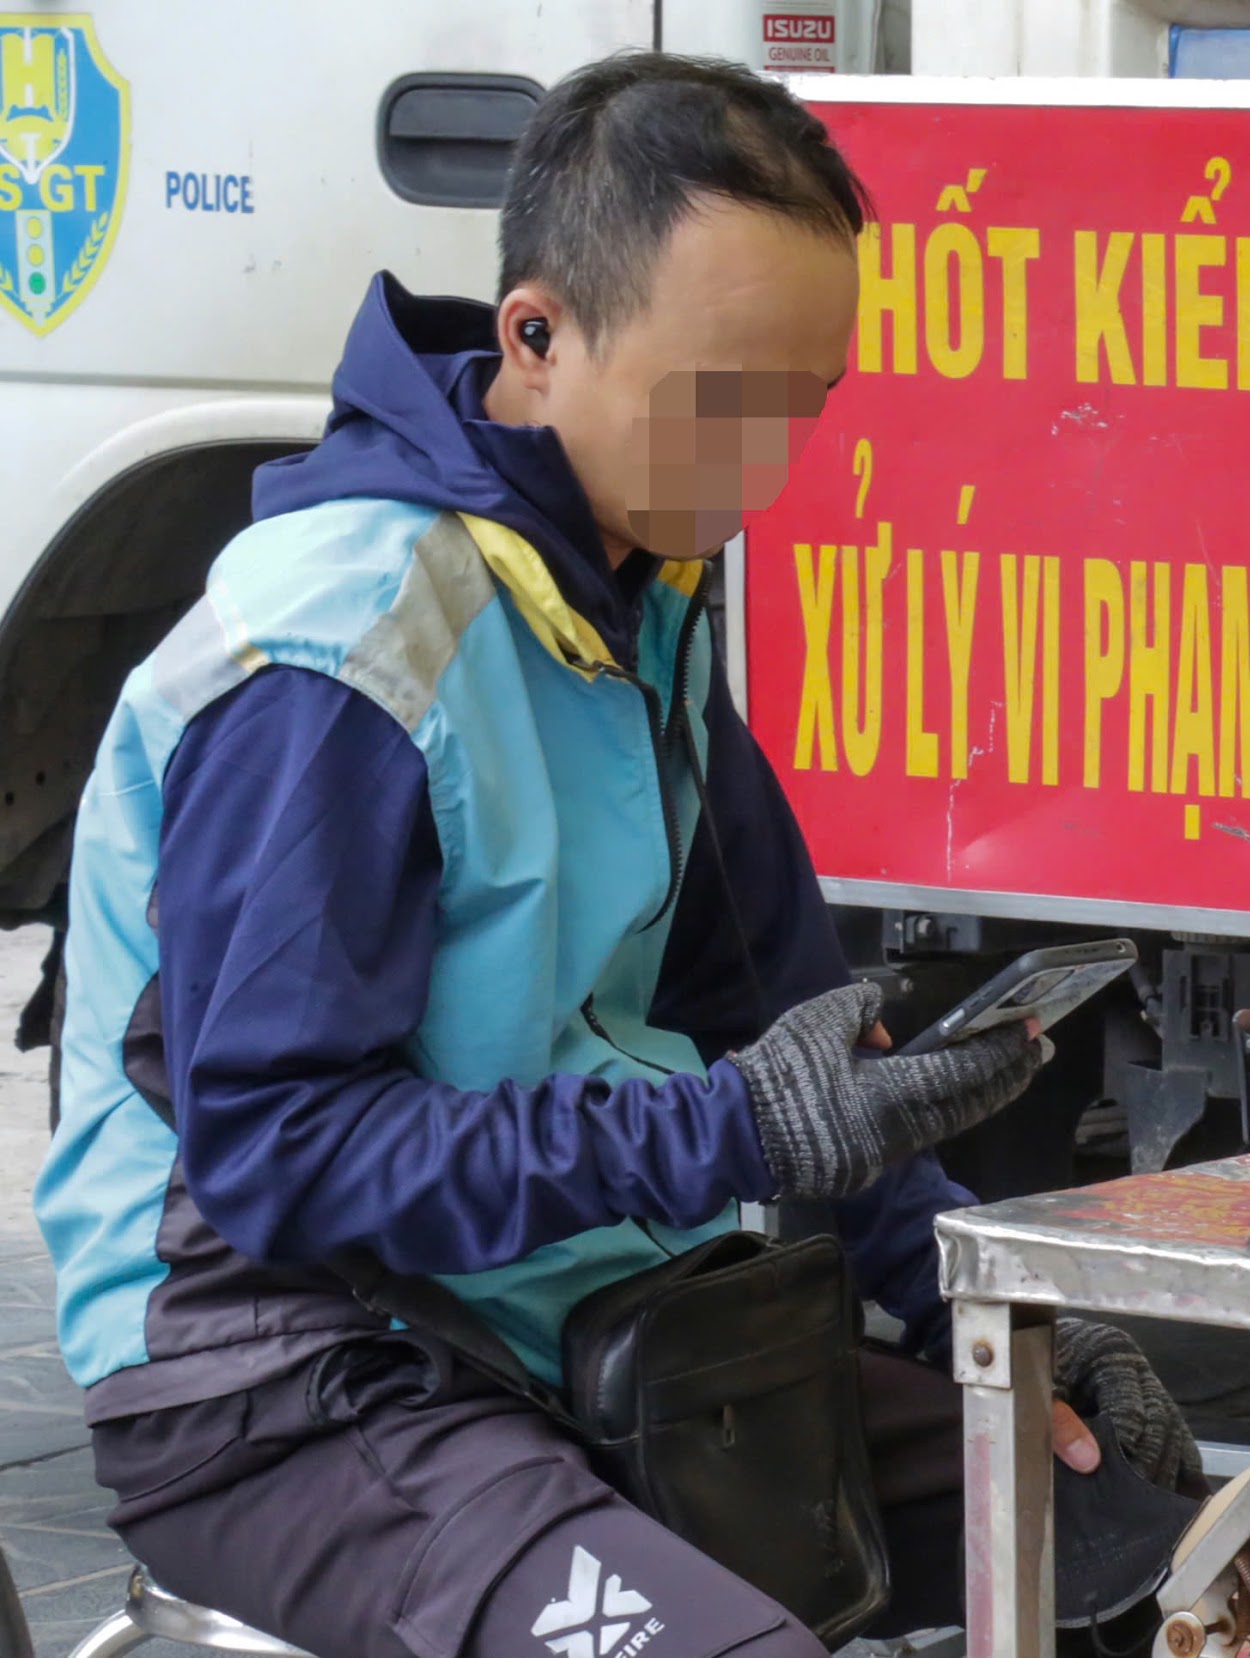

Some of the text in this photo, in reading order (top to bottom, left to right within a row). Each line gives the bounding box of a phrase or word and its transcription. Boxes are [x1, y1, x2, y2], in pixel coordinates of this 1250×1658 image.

[767, 19, 831, 38] ISUZU
[768, 47, 830, 61] GENUINE OIL
[166, 171, 254, 214] POLICE
[793, 438, 892, 777] XỬ
[906, 485, 980, 779] LÝ
[1000, 553, 1060, 786] VI
